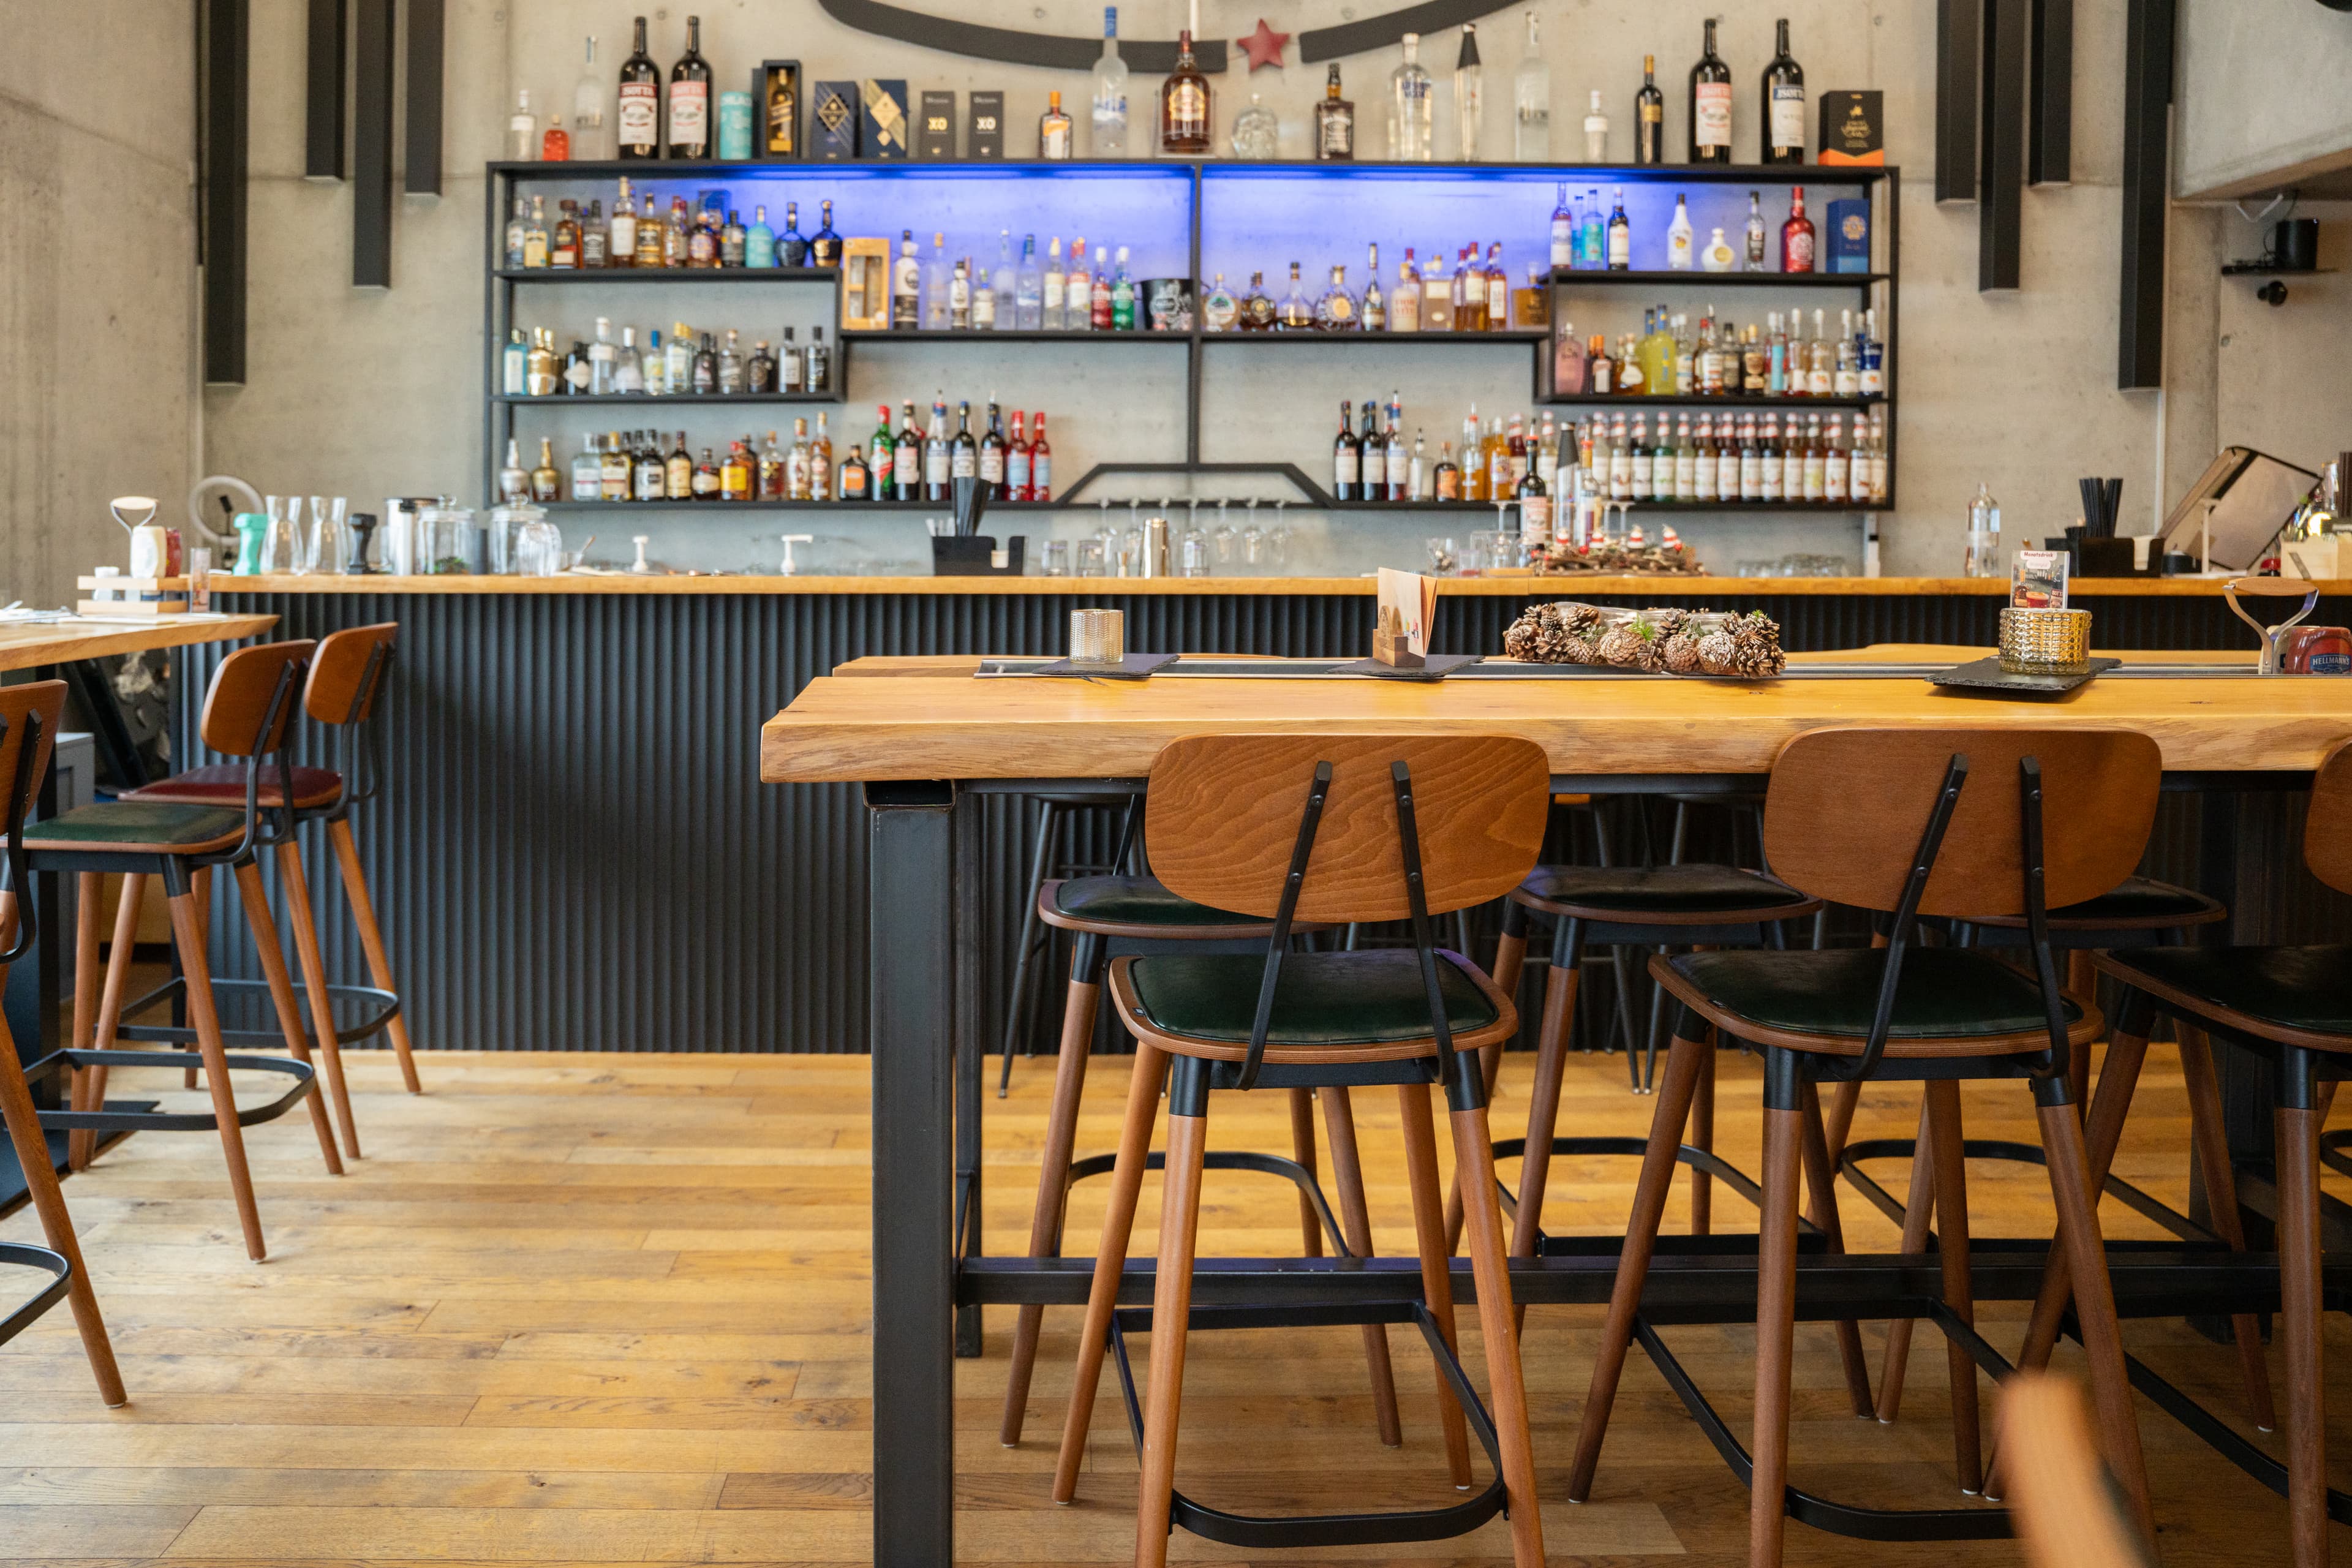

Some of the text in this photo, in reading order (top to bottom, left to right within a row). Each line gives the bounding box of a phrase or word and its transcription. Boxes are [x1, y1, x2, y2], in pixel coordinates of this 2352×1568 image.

[929, 117, 947, 130] XO
[977, 117, 996, 130] XO
[2313, 657, 2350, 665] HELLMANN'S
